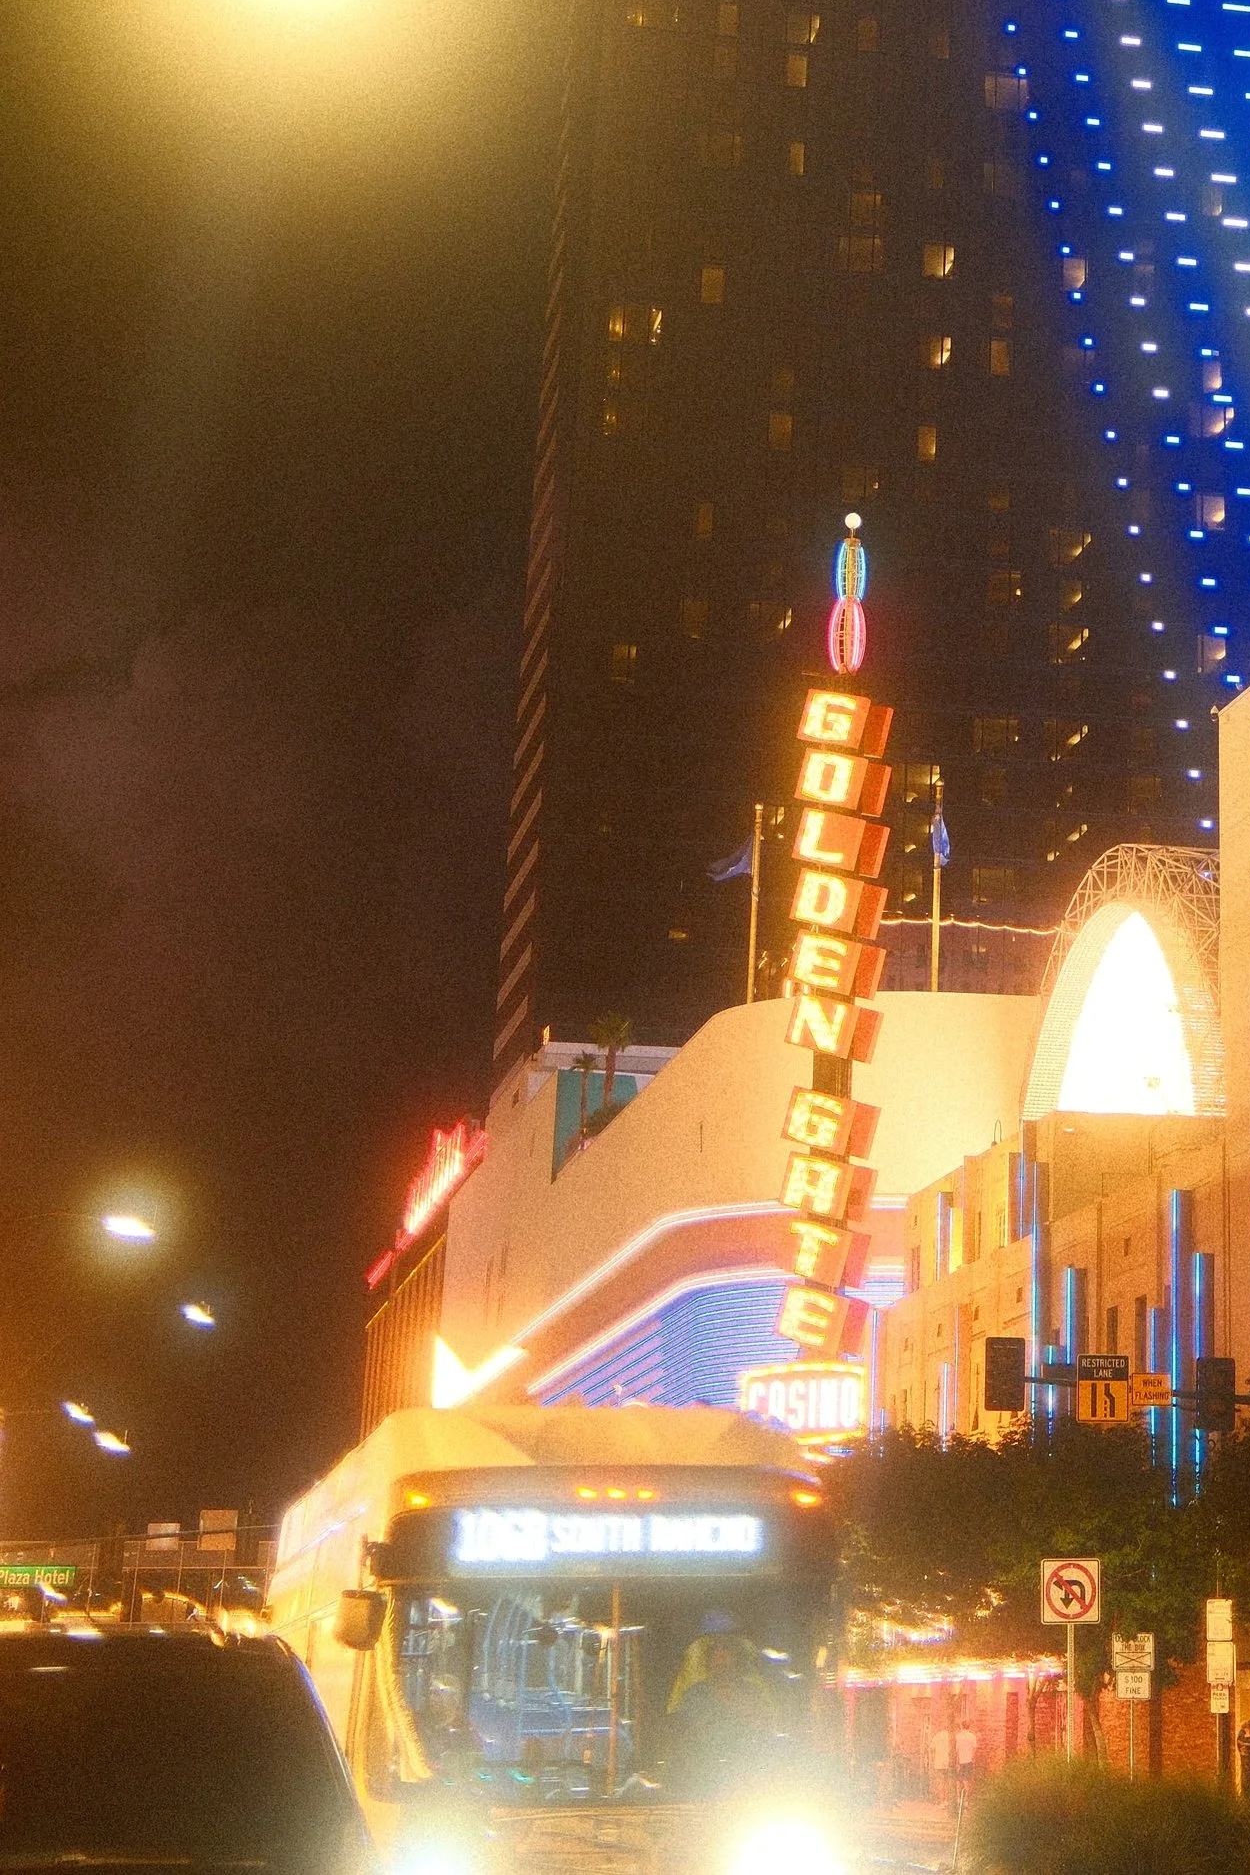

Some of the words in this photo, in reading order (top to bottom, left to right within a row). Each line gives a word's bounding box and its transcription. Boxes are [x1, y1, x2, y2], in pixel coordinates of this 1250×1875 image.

[790, 693, 857, 1054] GOLDEN
[779, 1091, 843, 1347] GATE
[1081, 1358, 1126, 1368] RESTRICTED
[1093, 1369, 1113, 1378] LANE
[1142, 1379, 1163, 1388] WHEN
[1135, 1391, 1170, 1401] FLASHING
[748, 1378, 860, 1430] CASINO
[34, 1568, 70, 1585] Hotel
[1125, 1686, 1142, 1695] FINE
